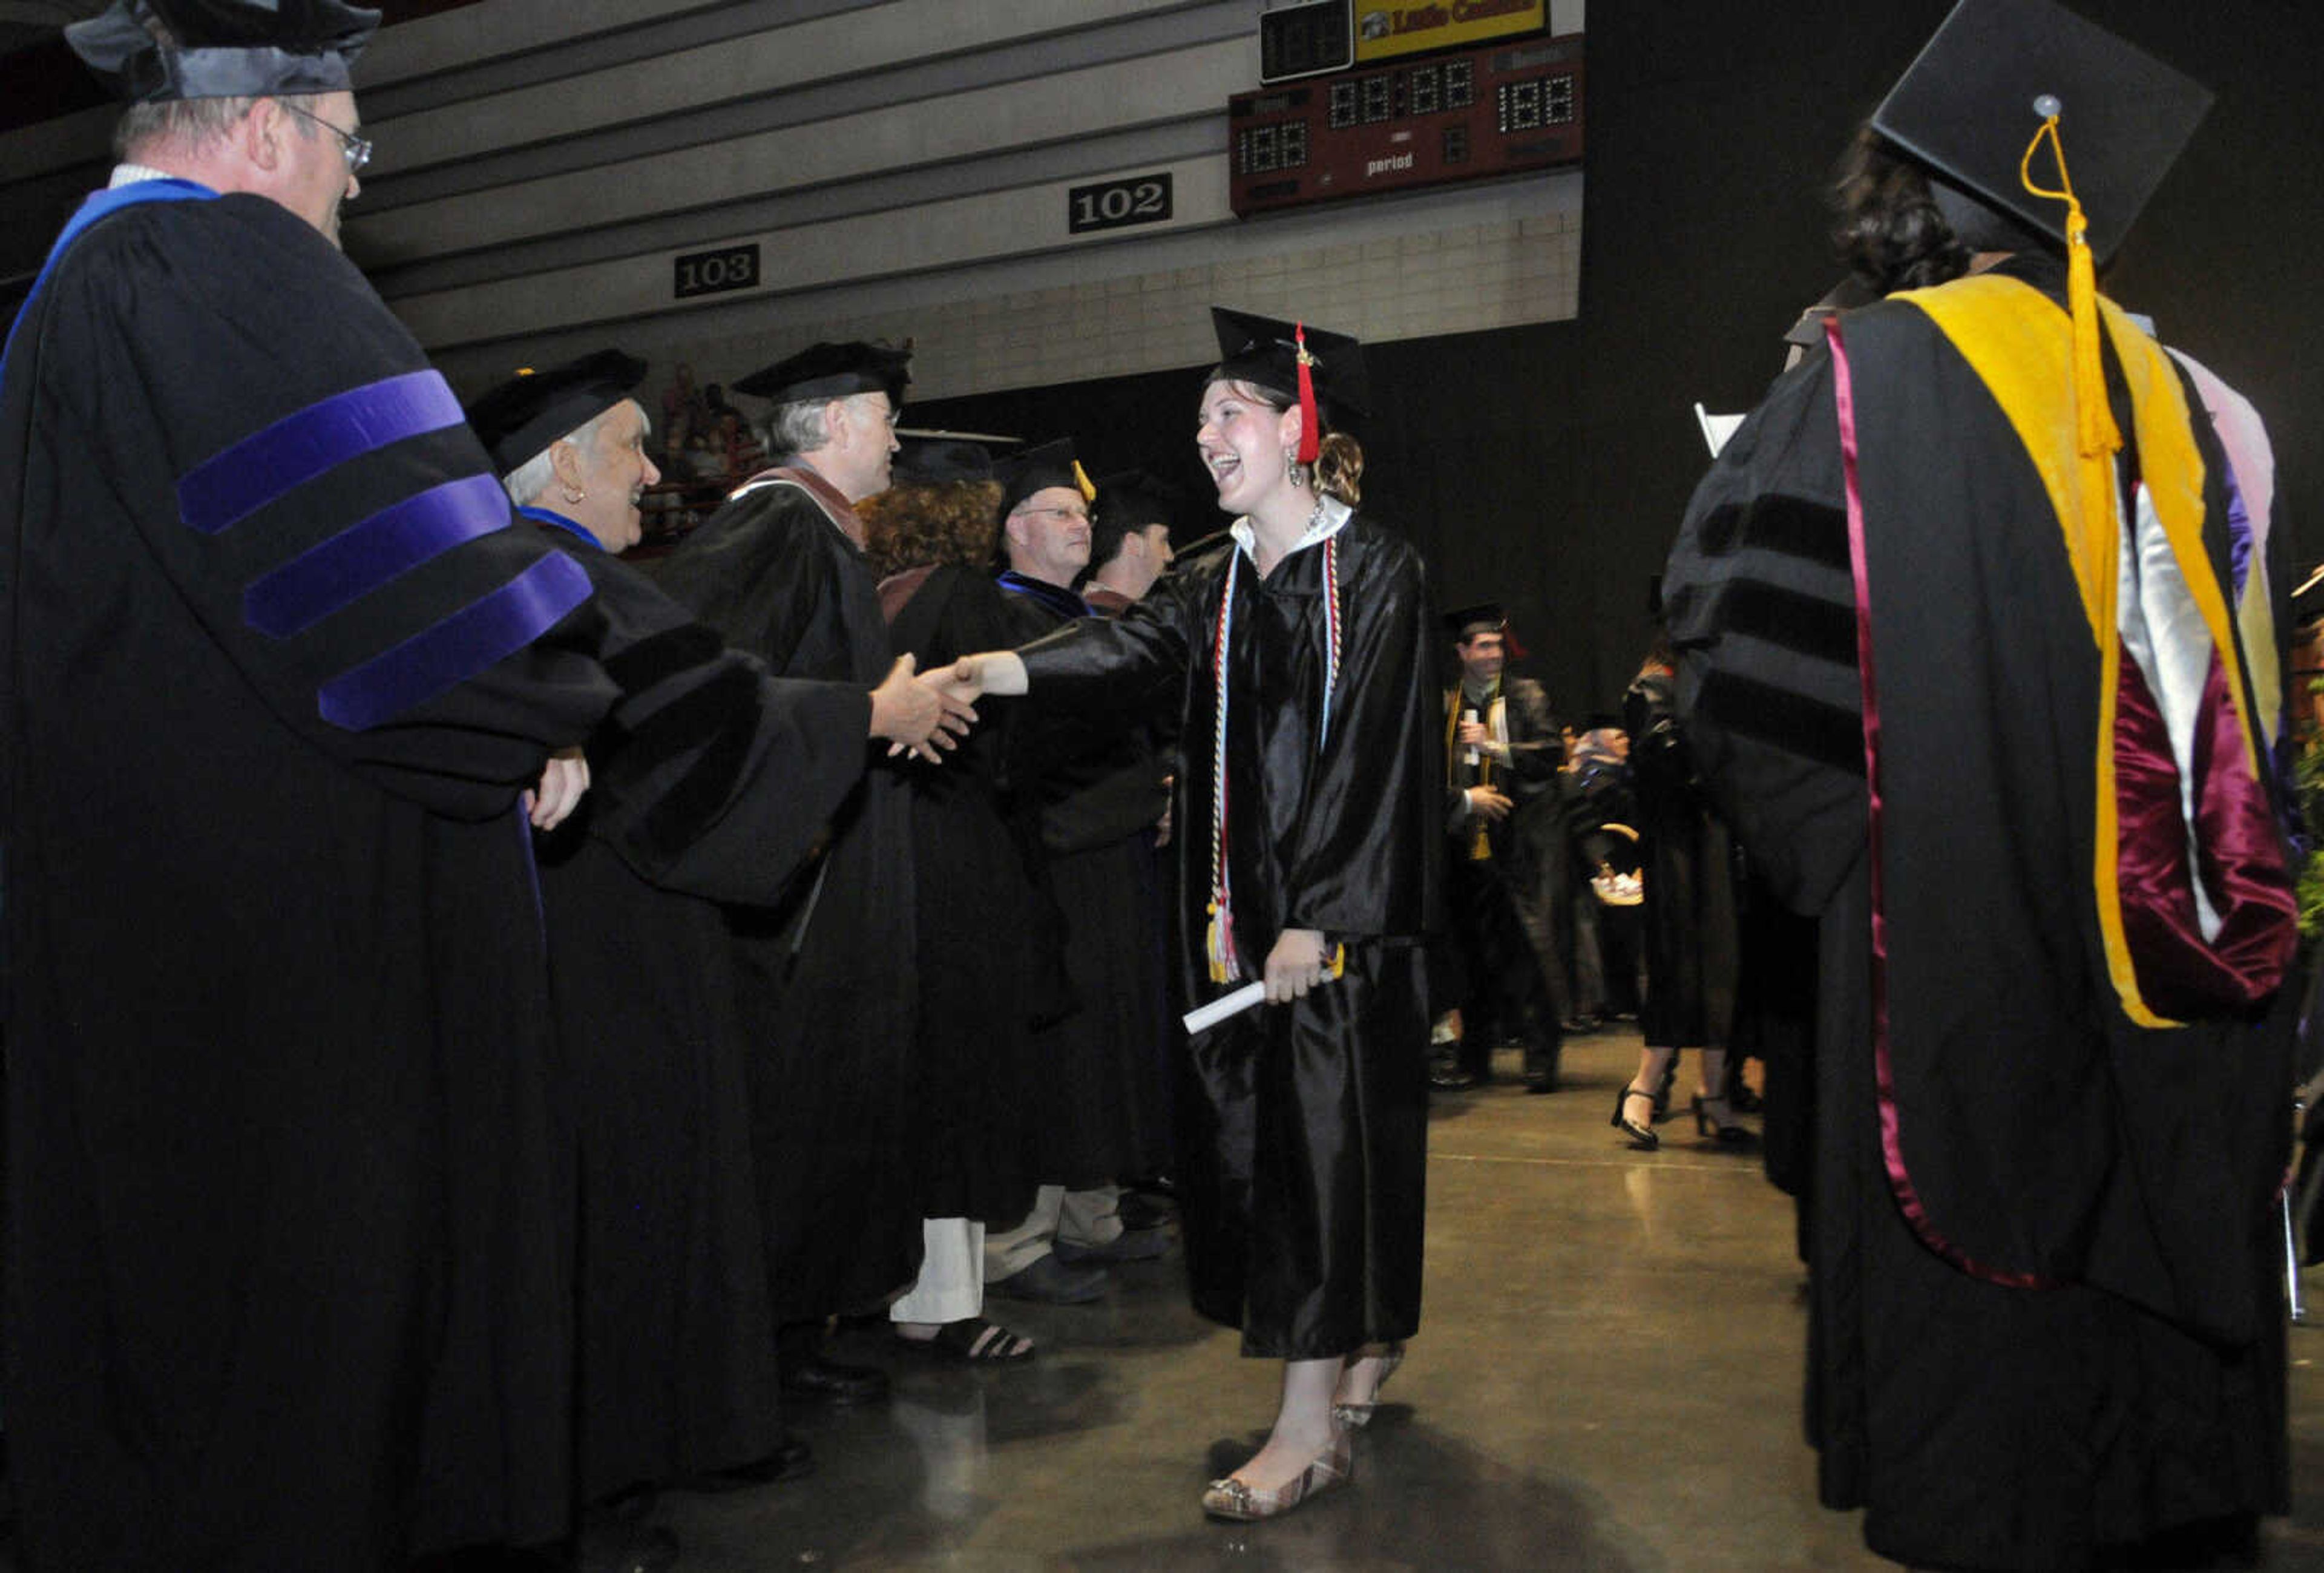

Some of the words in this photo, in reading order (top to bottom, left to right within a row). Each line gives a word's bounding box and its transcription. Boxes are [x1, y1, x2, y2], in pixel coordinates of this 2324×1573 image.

[1367, 151, 1413, 177] period
[1077, 183, 1163, 225] 102
[684, 253, 751, 291] 103
